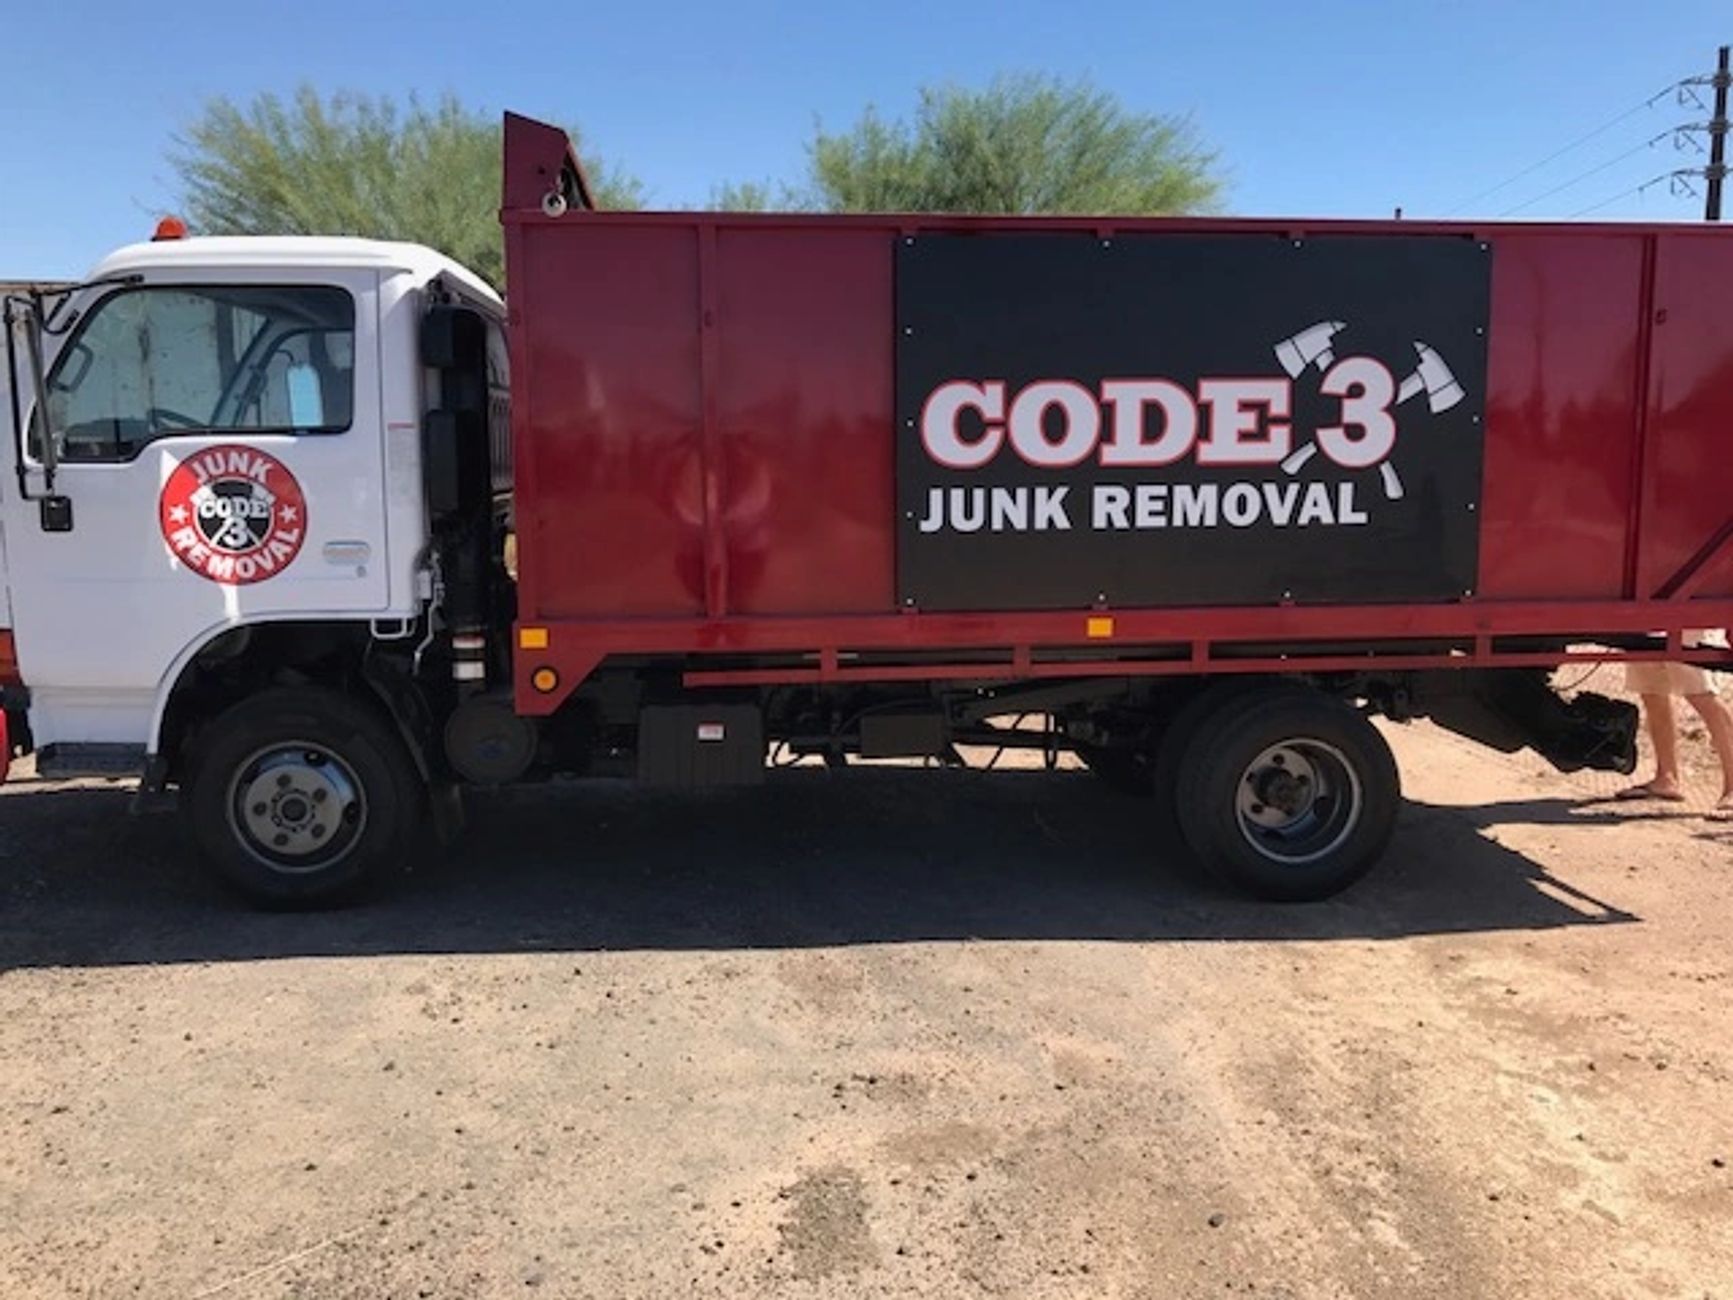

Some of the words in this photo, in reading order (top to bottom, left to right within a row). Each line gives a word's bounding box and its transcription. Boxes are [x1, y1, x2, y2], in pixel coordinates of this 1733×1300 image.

[920, 376, 1293, 469] CODE
[1315, 355, 1397, 468] 3
[192, 452, 274, 484] JUNK
[200, 497, 270, 518] CODE
[920, 486, 1072, 533] JUNK
[1092, 481, 1369, 530] REMOVAL
[223, 516, 249, 546] 3
[170, 527, 300, 579] REMOVAL
